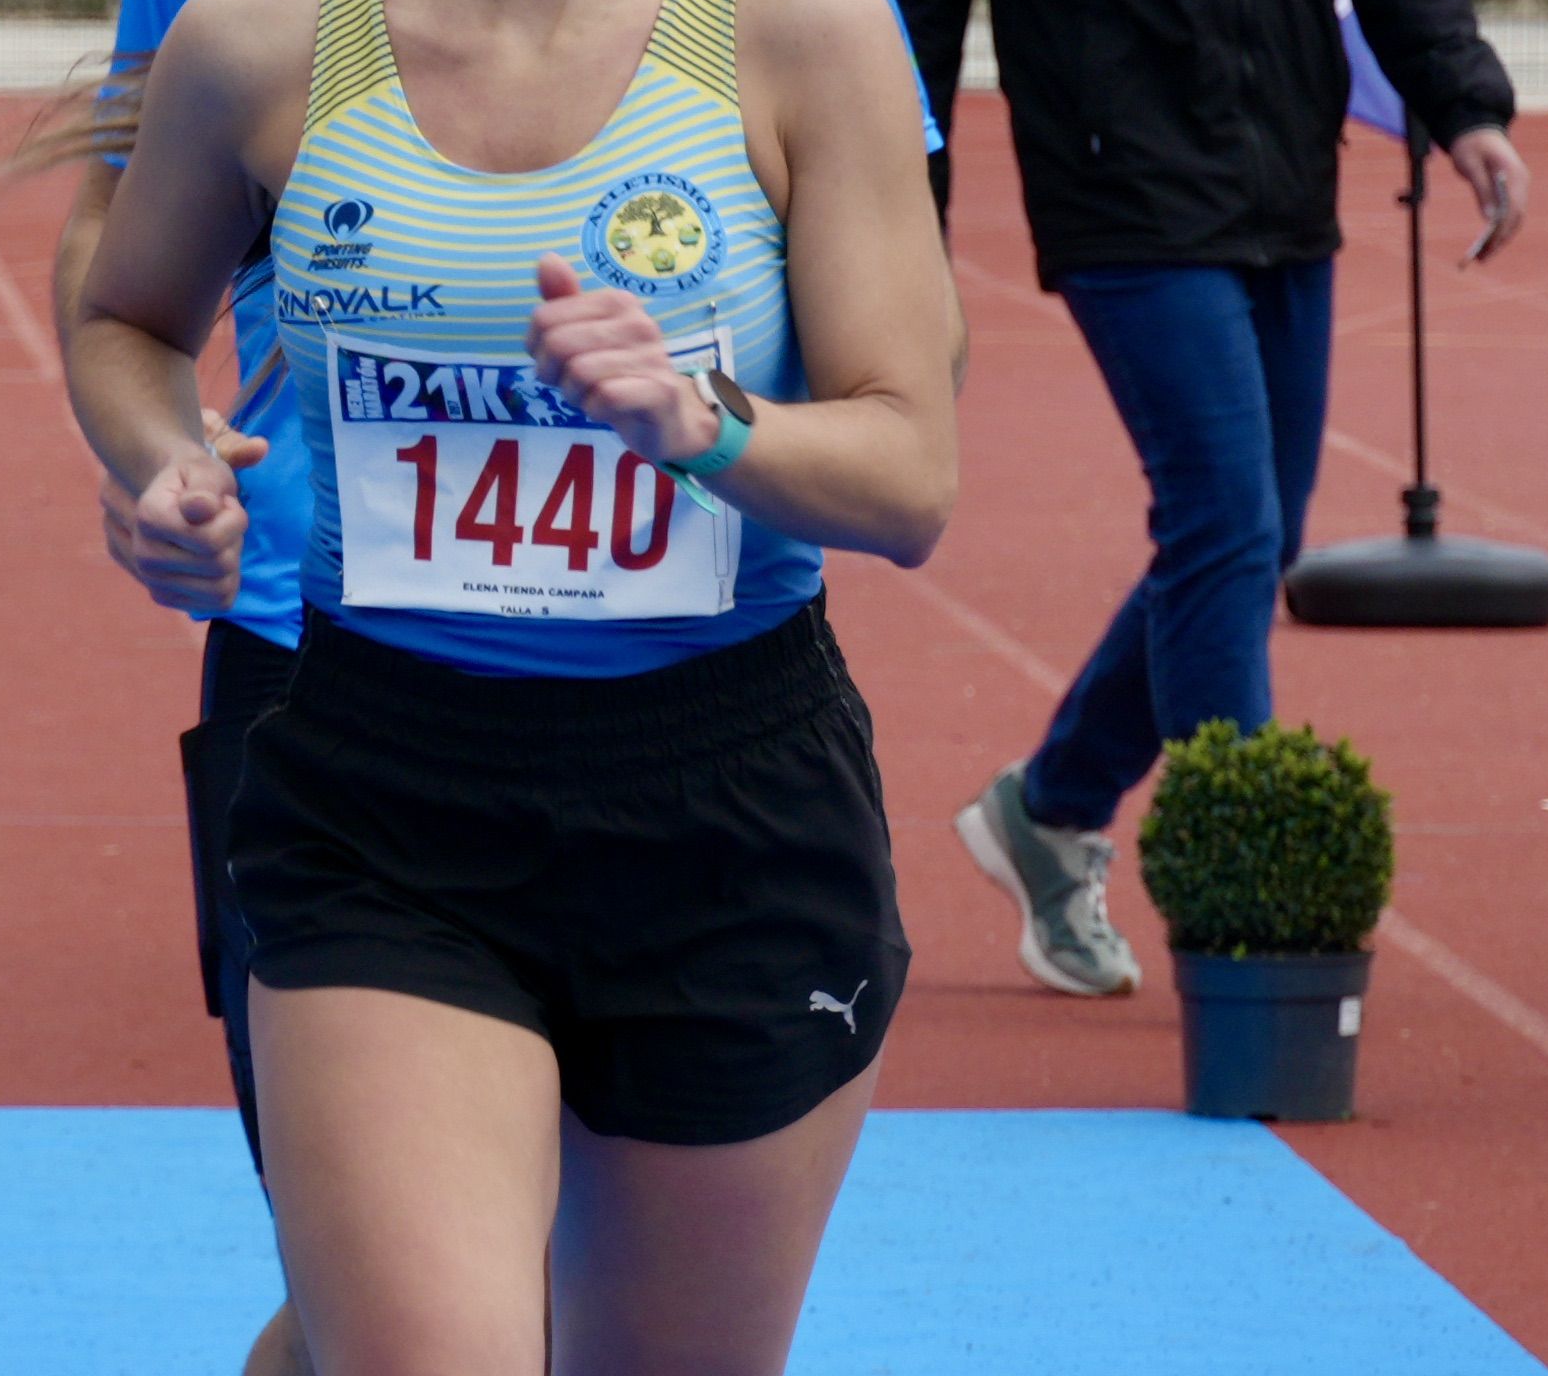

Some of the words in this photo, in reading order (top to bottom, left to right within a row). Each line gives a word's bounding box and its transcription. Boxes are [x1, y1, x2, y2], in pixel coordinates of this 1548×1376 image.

[590, 173, 712, 226] ATLETISMO
[384, 361, 512, 421] 21K
[395, 433, 675, 574] 1440
[462, 582, 499, 594] ELENA
[503, 585, 545, 596] TIENDA
[548, 586, 605, 600] CAMPAÑA
[499, 605, 532, 616] TALLA
[541, 606, 550, 617] S
